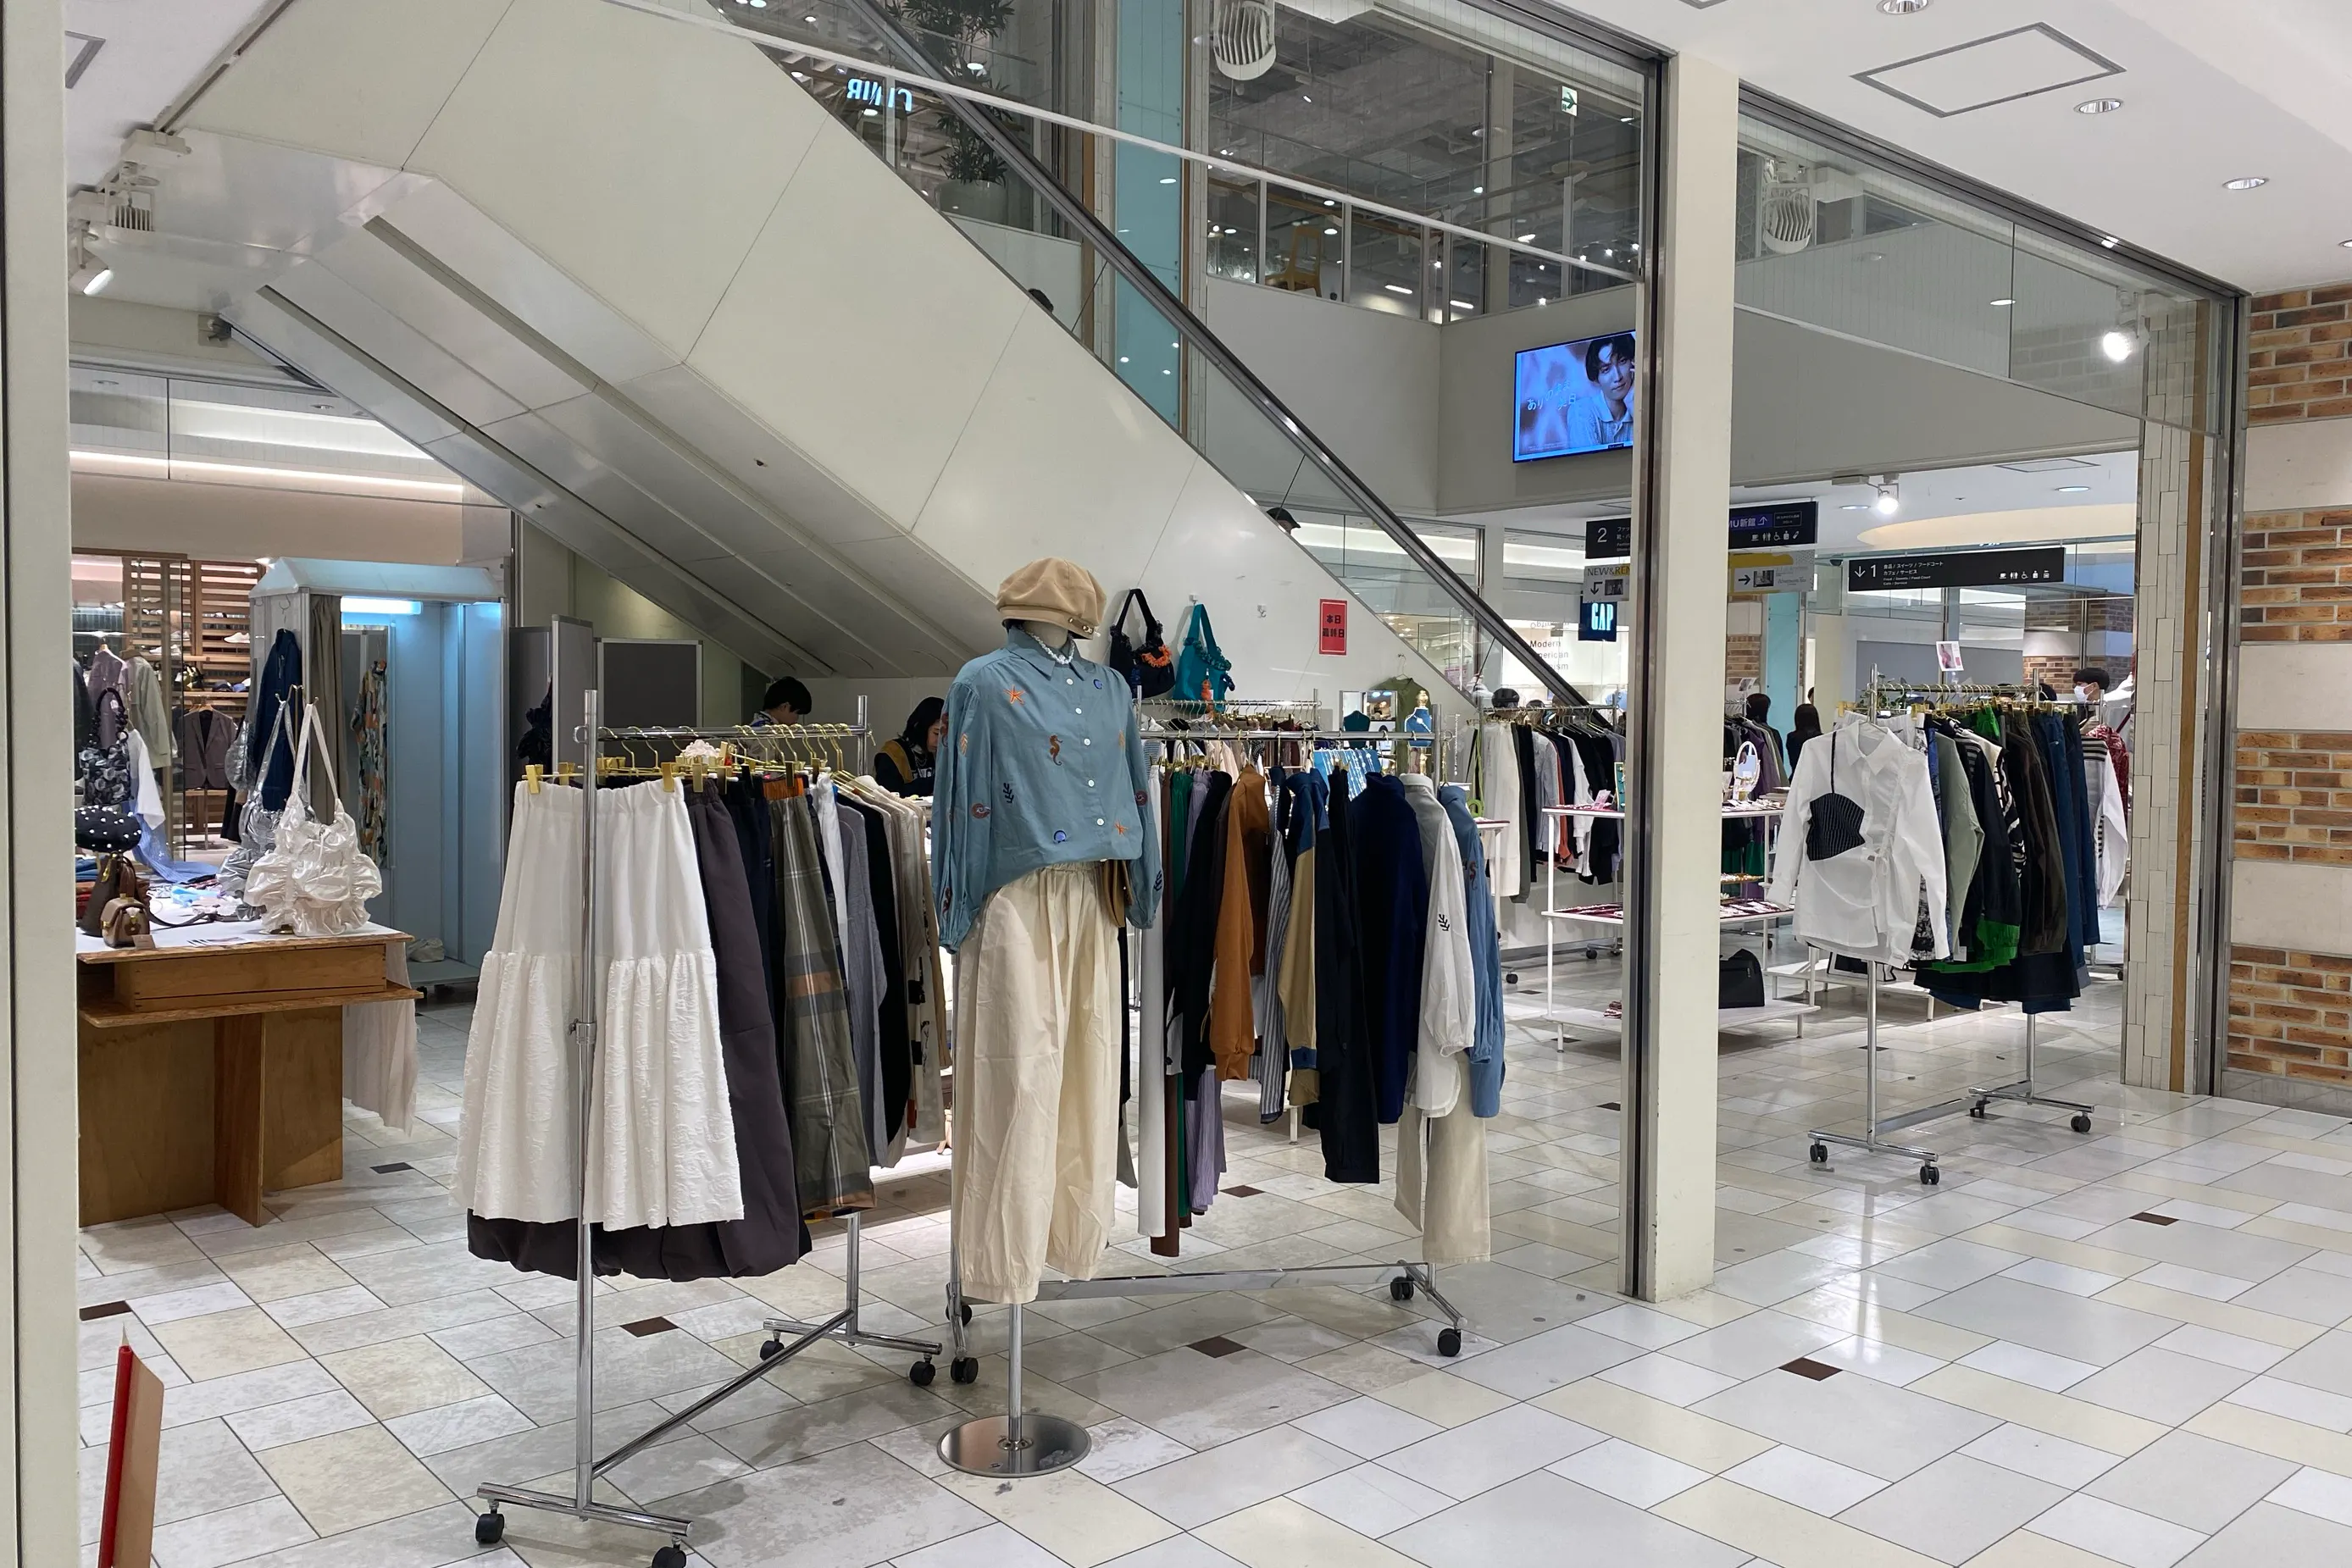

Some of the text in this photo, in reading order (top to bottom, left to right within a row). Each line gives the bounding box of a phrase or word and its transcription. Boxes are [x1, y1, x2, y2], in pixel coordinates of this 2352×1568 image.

[1597, 527, 1607, 543] 2
[1870, 564, 1877, 578] 1
[1326, 614, 1341, 624] 本日
[1591, 602, 1614, 631] GAP
[1529, 640, 1562, 648] Modern
